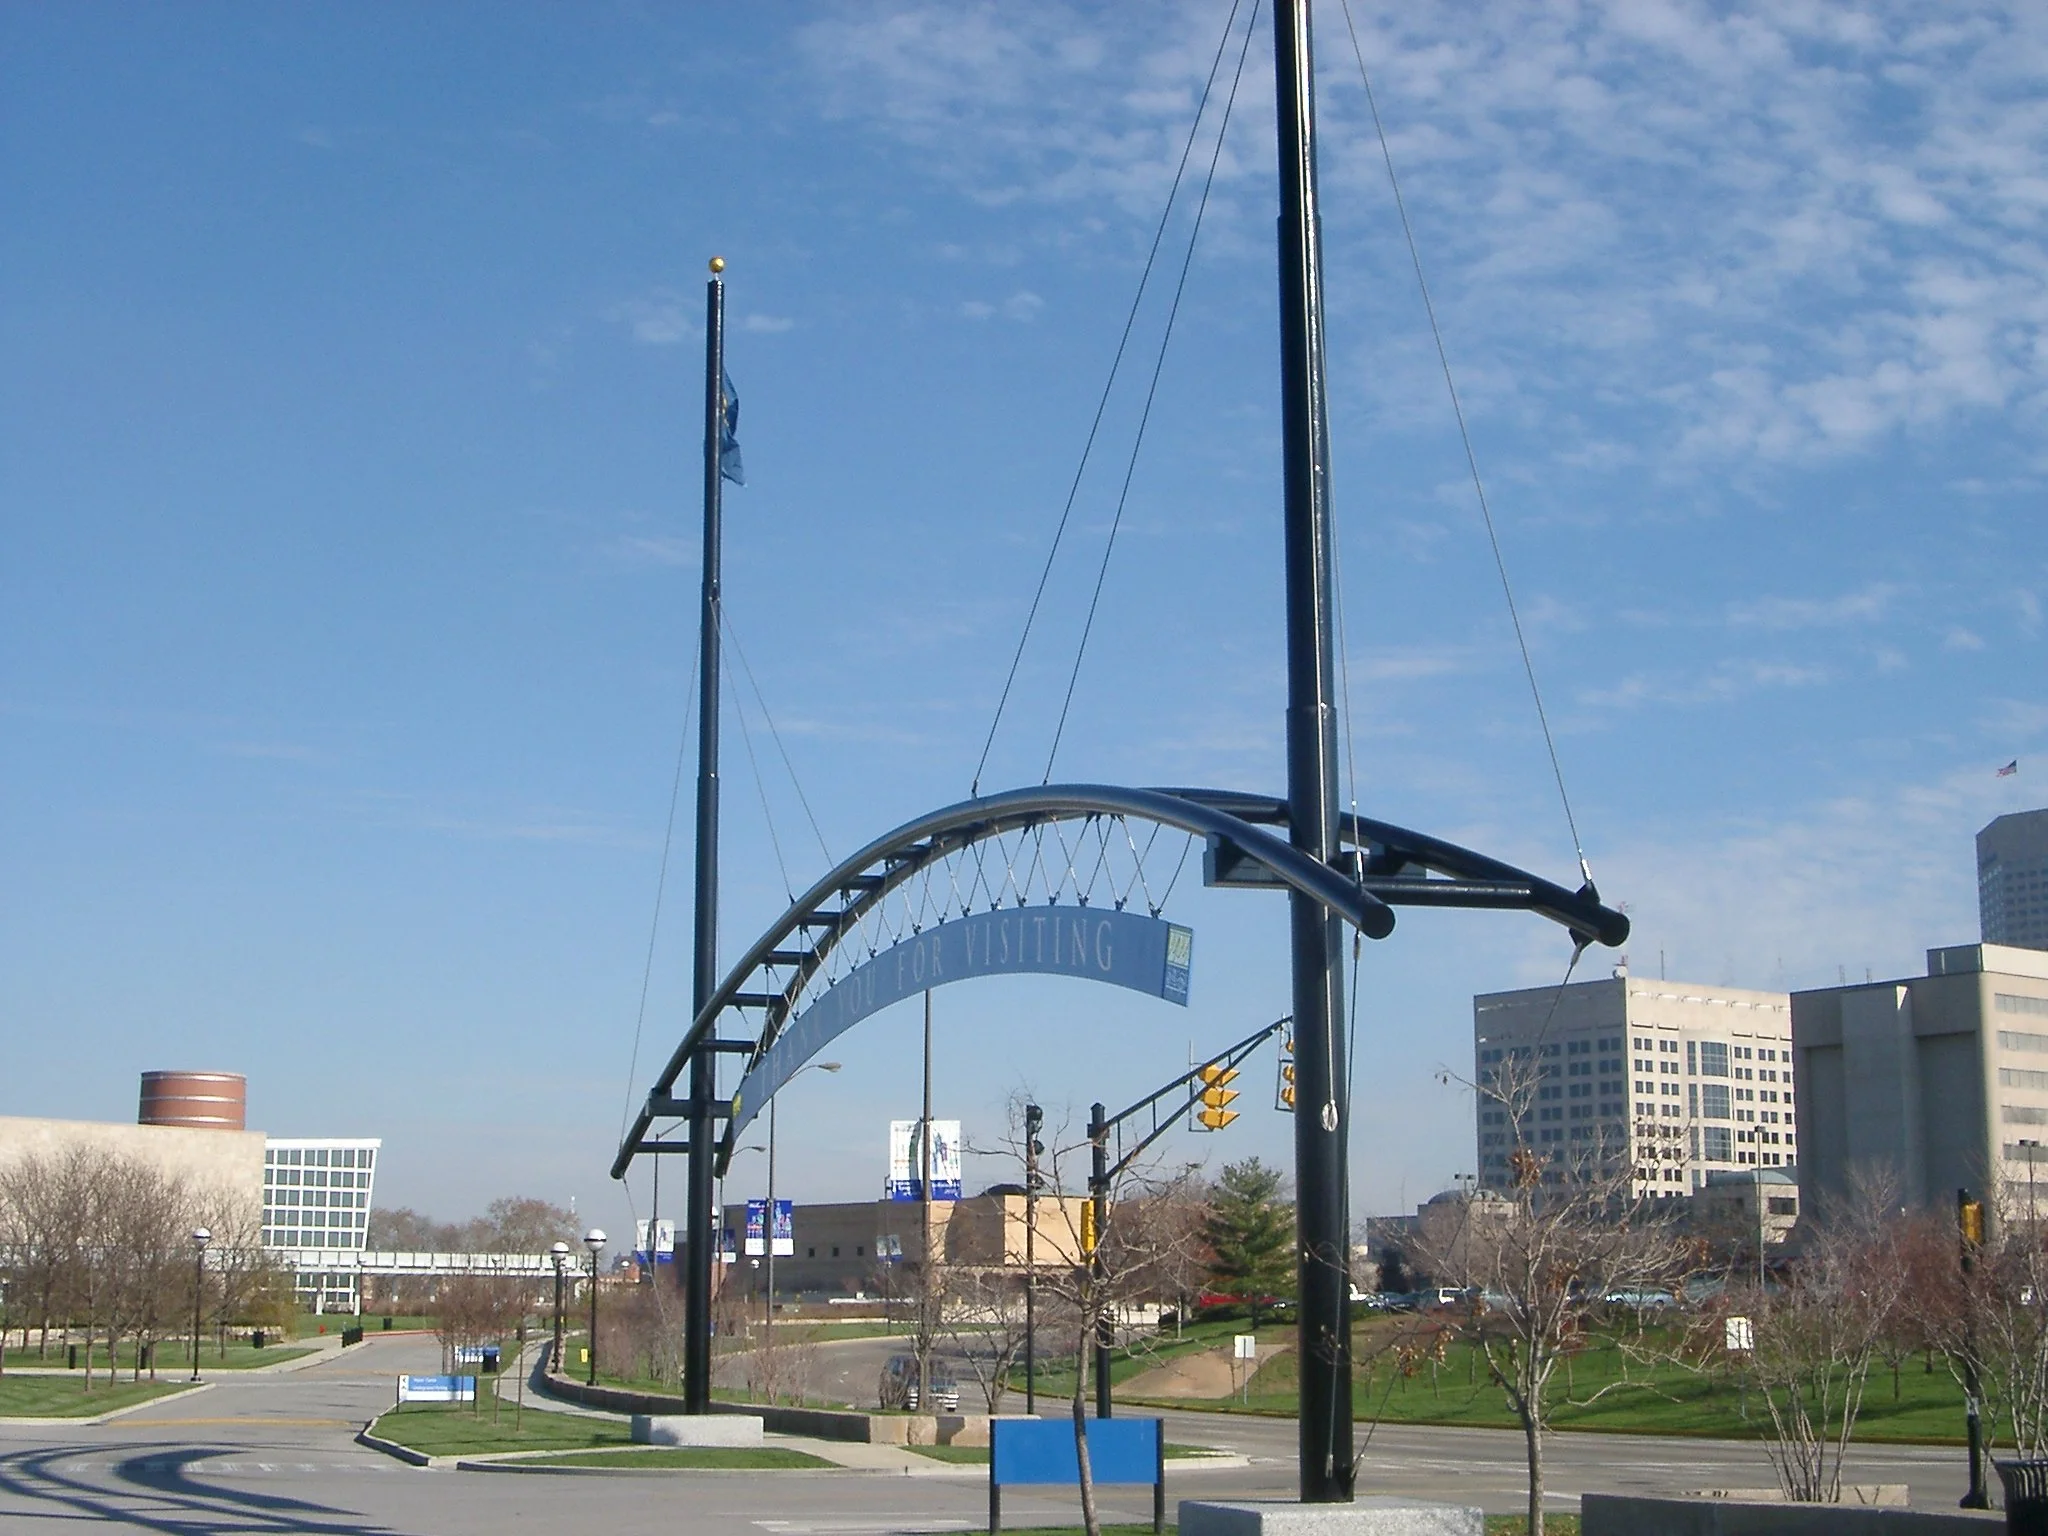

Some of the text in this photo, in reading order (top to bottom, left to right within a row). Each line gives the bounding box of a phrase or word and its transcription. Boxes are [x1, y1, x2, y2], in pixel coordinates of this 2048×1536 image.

[758, 915, 1113, 1097] THANK YOU FOR VISITING
